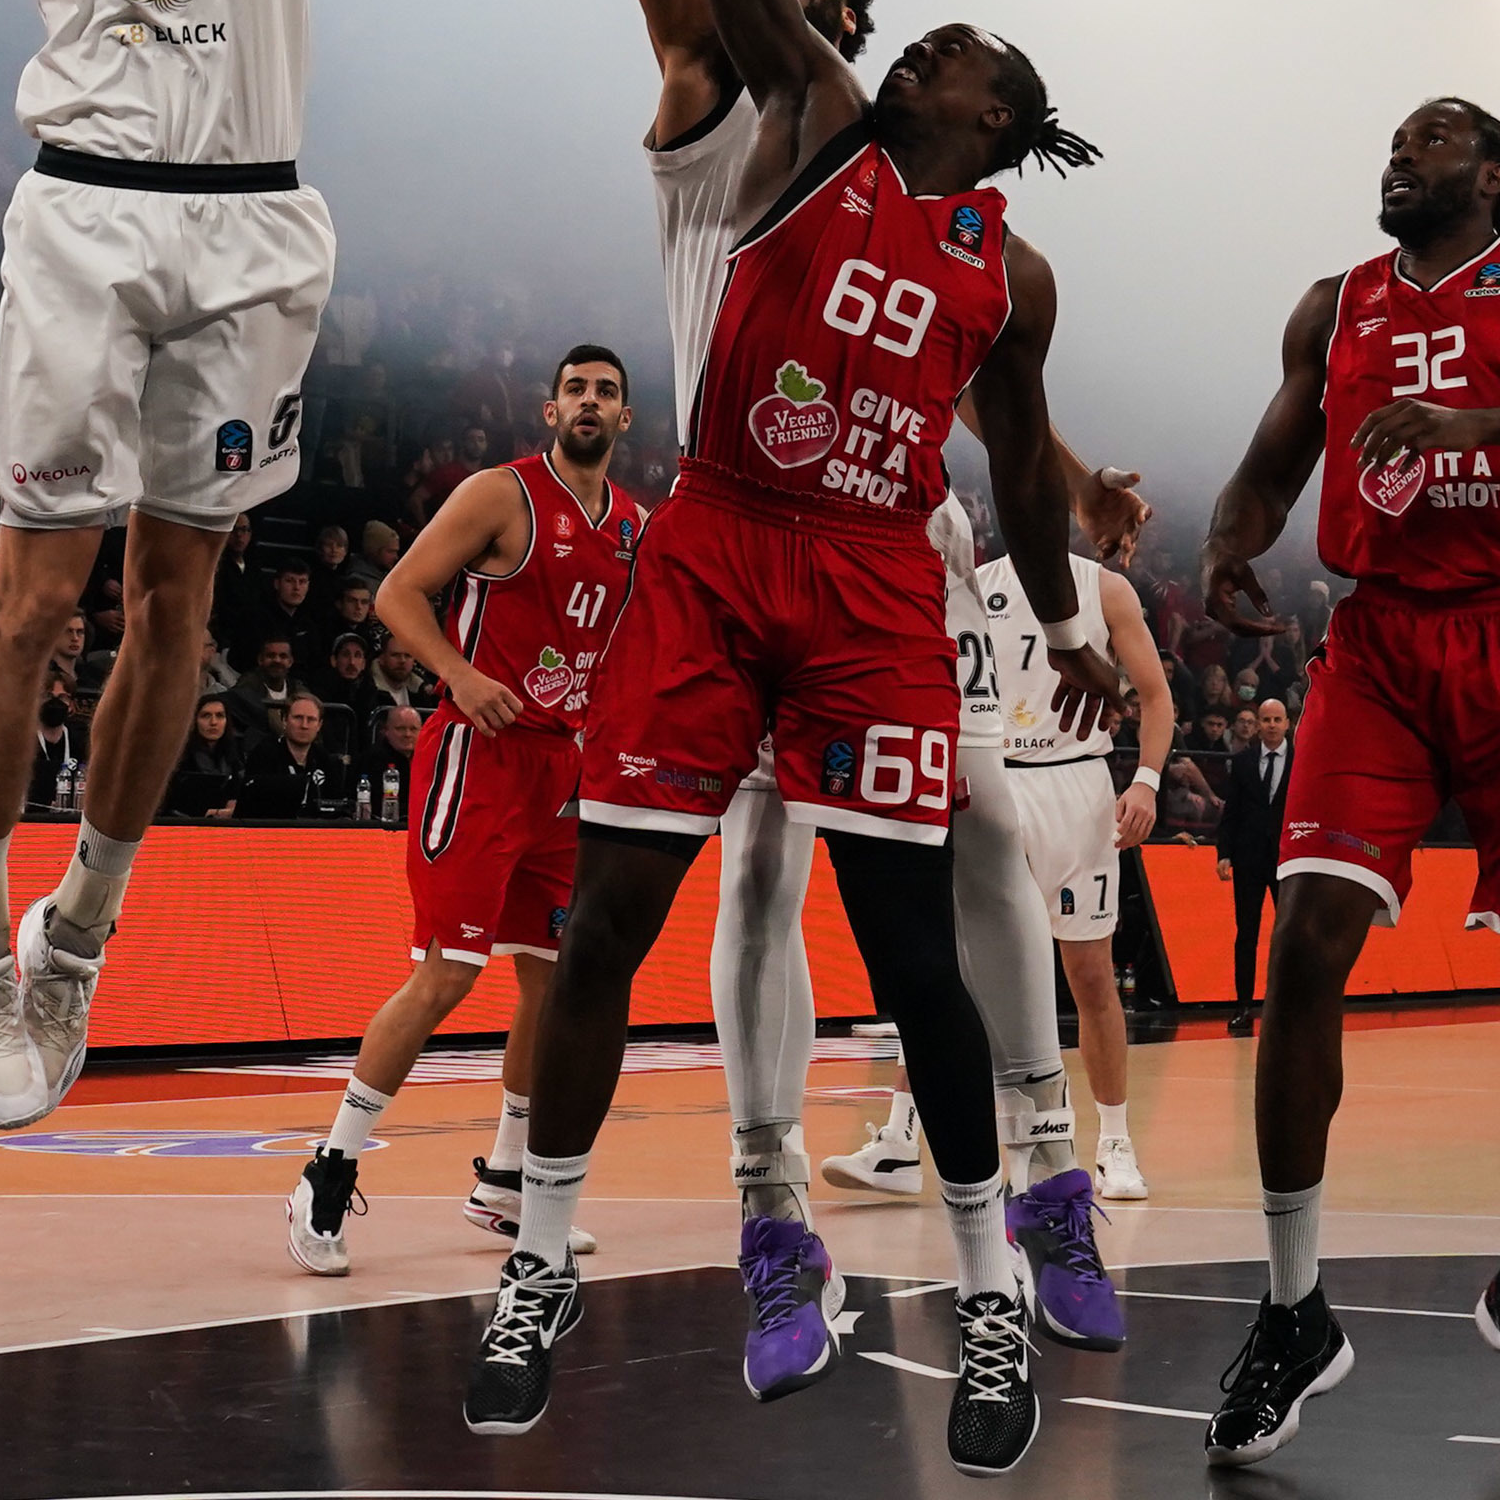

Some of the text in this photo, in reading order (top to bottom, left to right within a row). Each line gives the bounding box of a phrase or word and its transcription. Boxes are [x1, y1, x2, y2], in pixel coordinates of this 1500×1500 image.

[154, 23, 227, 45] BLACK
[844, 185, 874, 211] Reebo
[941, 241, 984, 268] oneteam
[822, 257, 937, 358] 69
[1391, 325, 1468, 397] 32
[268, 393, 301, 450] 5
[774, 409, 827, 428] VEGAN
[850, 387, 926, 445] GIVE
[765, 421, 834, 446] FRIENDLY
[259, 448, 291, 468] CRAFT
[844, 424, 907, 475] IT A
[29, 465, 91, 481] VEOLIA
[1377, 468, 1403, 488] VEG
[1434, 451, 1492, 478] IT A
[822, 458, 909, 511] SHOT
[1376, 464, 1422, 506] FRIENDLY
[1426, 482, 1500, 509] SHOT
[566, 581, 607, 628] 41
[575, 650, 599, 669] GIV
[1020, 634, 1037, 671] 7
[1014, 738, 1055, 749] BLACK
[618, 752, 658, 767] Reebok
[860, 724, 949, 810] 69
[1288, 821, 1320, 830] Reebok
[1093, 873, 1108, 912] 7
[1029, 1118, 1070, 1136] ZAMST
